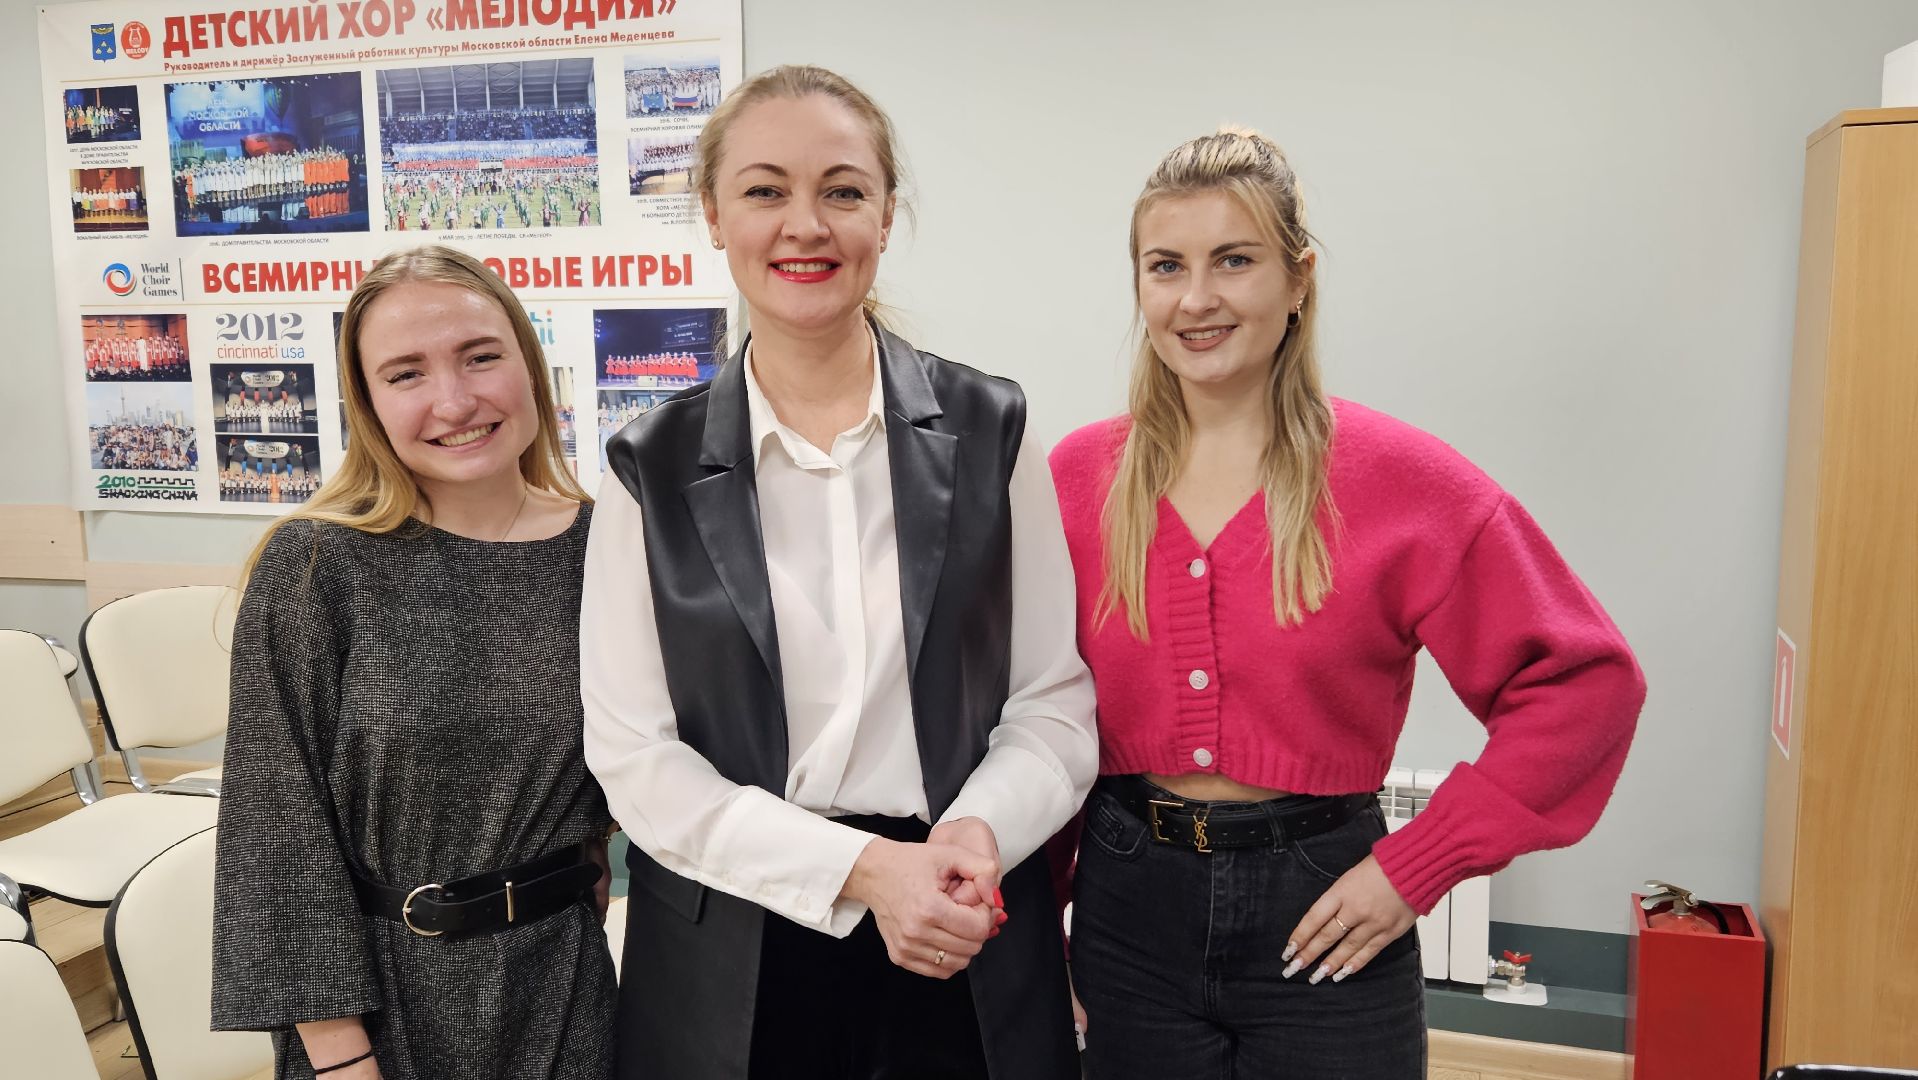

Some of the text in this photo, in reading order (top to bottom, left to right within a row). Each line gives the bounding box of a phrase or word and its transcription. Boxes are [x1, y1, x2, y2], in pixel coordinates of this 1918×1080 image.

[163, 0, 328, 58] ДЕТСКИЙ
[337, 0, 415, 39] ХОР
[164, 61, 230, 74] Руководитель
[241, 54, 284, 69] дирижёр
[287, 49, 355, 65] Заслуженный
[358, 46, 406, 61] работник
[408, 43, 459, 58] культуры
[461, 38, 526, 51] Московской
[528, 35, 571, 48] области
[574, 34, 607, 46] Елена
[610, 29, 675, 43] Меденцева
[199, 120, 241, 132] ОБЛАСТИ
[141, 262, 169, 273] World
[202, 254, 692, 293] ВСЕМИРН ОВЫЕ ИГРЫ
[142, 274, 170, 285] Choir
[143, 286, 178, 297] Games
[215, 312, 304, 342] 2012
[217, 343, 305, 360] cincinnati usa
[96, 474, 136, 489] 2010
[98, 488, 198, 501] SHAOXING CHINA
